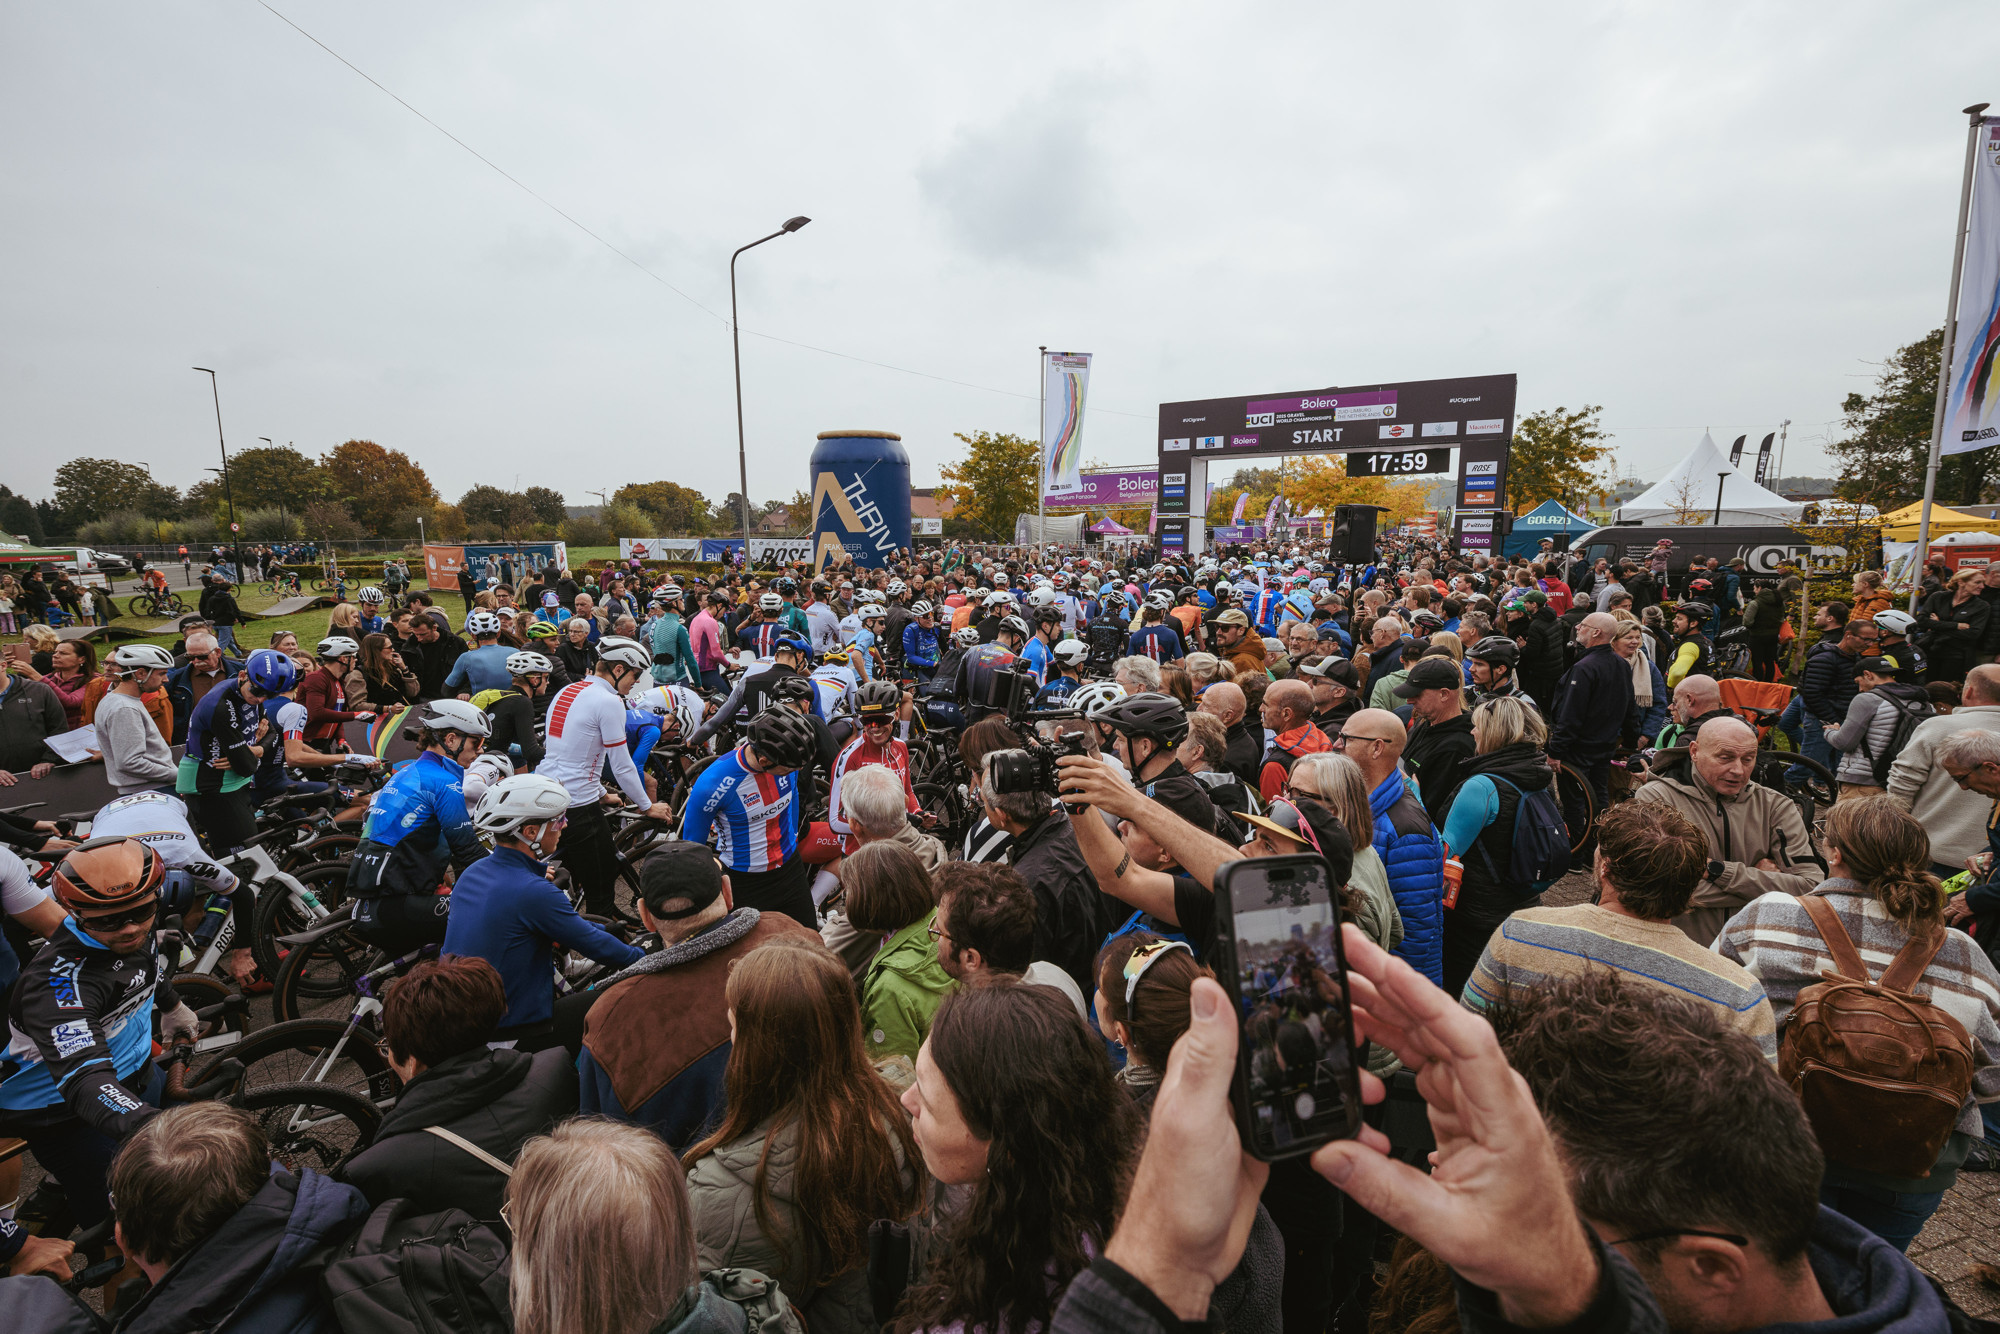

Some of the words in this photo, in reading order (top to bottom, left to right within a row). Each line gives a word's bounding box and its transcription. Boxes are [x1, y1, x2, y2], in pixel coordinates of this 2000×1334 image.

[1300, 398, 1338, 409] Bolero
[1450, 396, 1480, 404] #UCIgravel
[1182, 416, 1206, 424] #UCIgravel
[1250, 414, 1273, 426] UCI
[1293, 415, 1332, 423] CHAMPIONSHIPS
[1469, 423, 1501, 431] Maastricht
[1233, 437, 1257, 445] Bolero
[1292, 428, 1344, 444] START
[1367, 452, 1428, 473] 17:59
[1471, 464, 1492, 472] ROSE
[1117, 476, 1158, 490] Boler
[1527, 515, 1572, 525] GOLAZO
[761, 548, 811, 563] ROSE
[752, 637, 775, 646] USA
[264, 655, 272, 675] TREK
[703, 775, 736, 813] sazka
[743, 793, 760, 805] czech
[746, 799, 761, 807] team
[183, 861, 221, 880] KTM
[215, 920, 236, 953] ROSE
